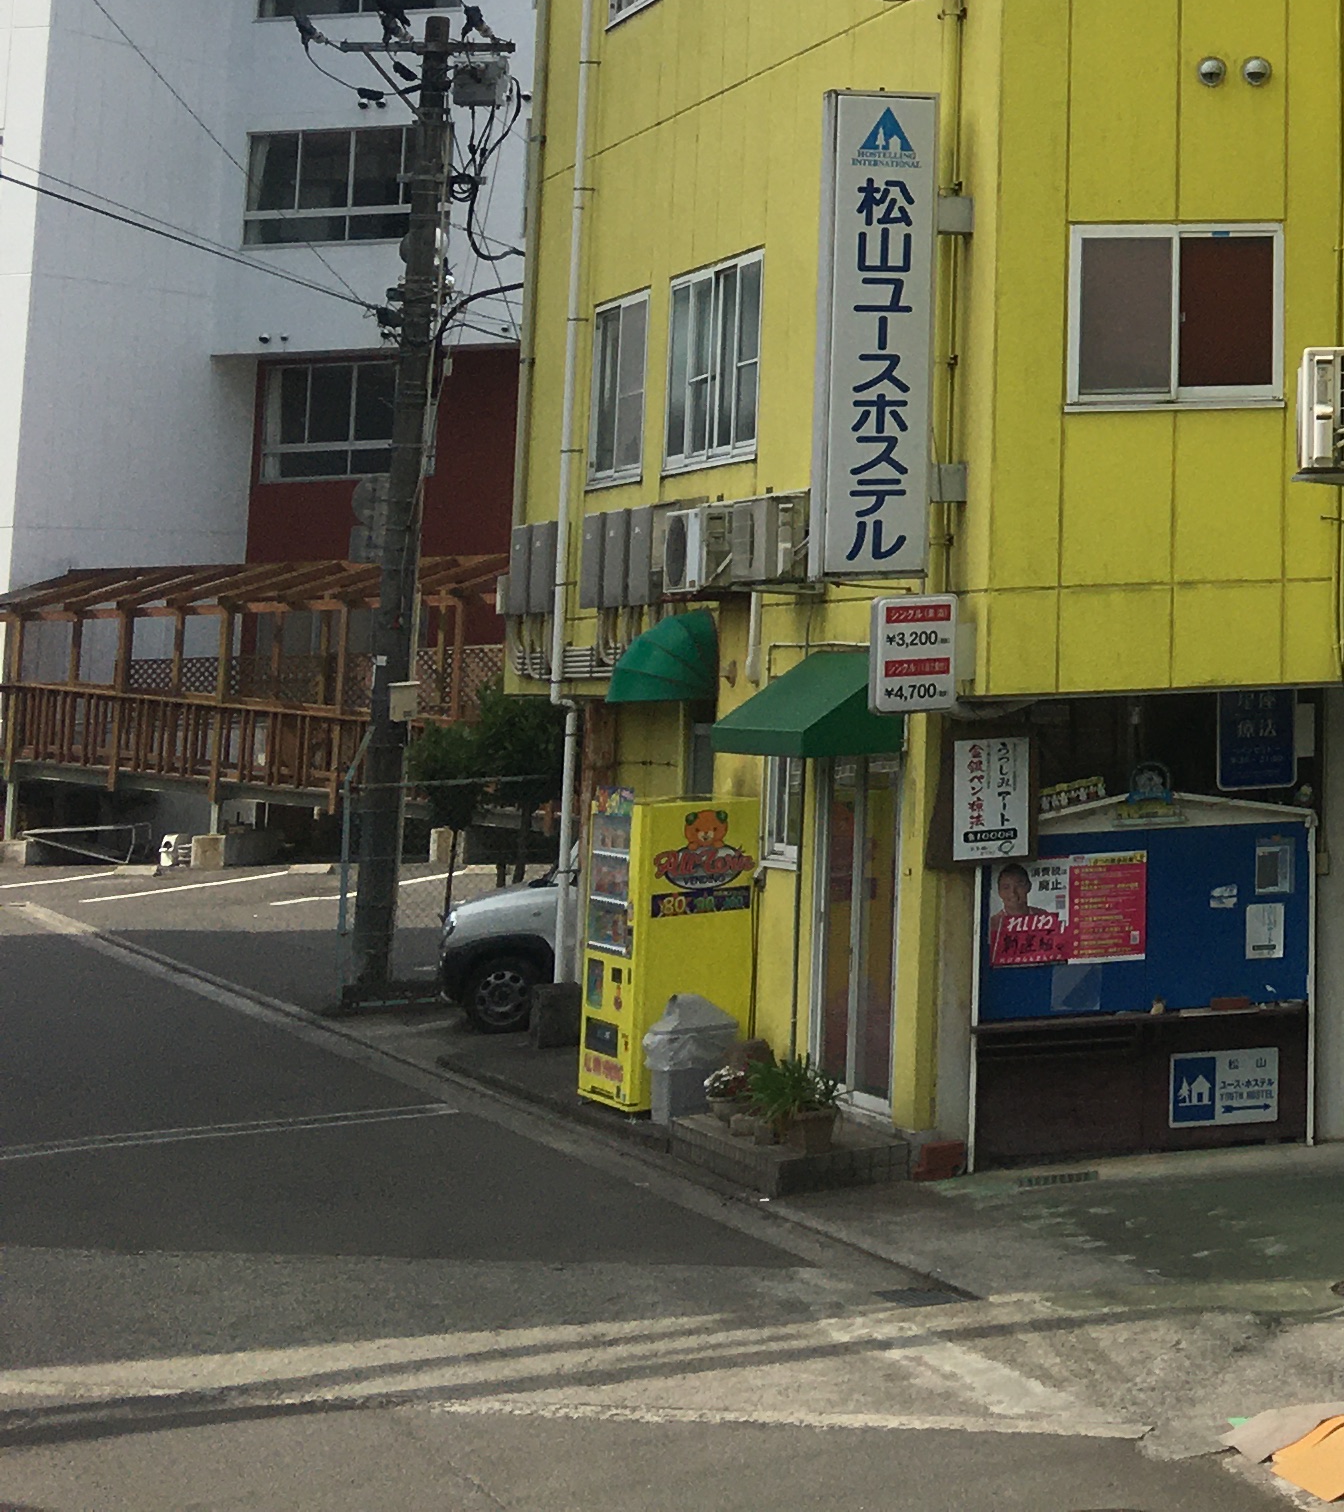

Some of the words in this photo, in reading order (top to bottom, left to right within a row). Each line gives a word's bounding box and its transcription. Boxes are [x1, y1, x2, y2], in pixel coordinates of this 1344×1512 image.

[851, 158, 922, 169] INTERNATIONAL
[857, 149, 917, 160] HOSTELLING
[846, 176, 916, 563] 松山ユースホステル
[886, 630, 938, 648] ¥3,200
[884, 682, 937, 701] ¥4,700
[996, 741, 1012, 827] うつしみアート
